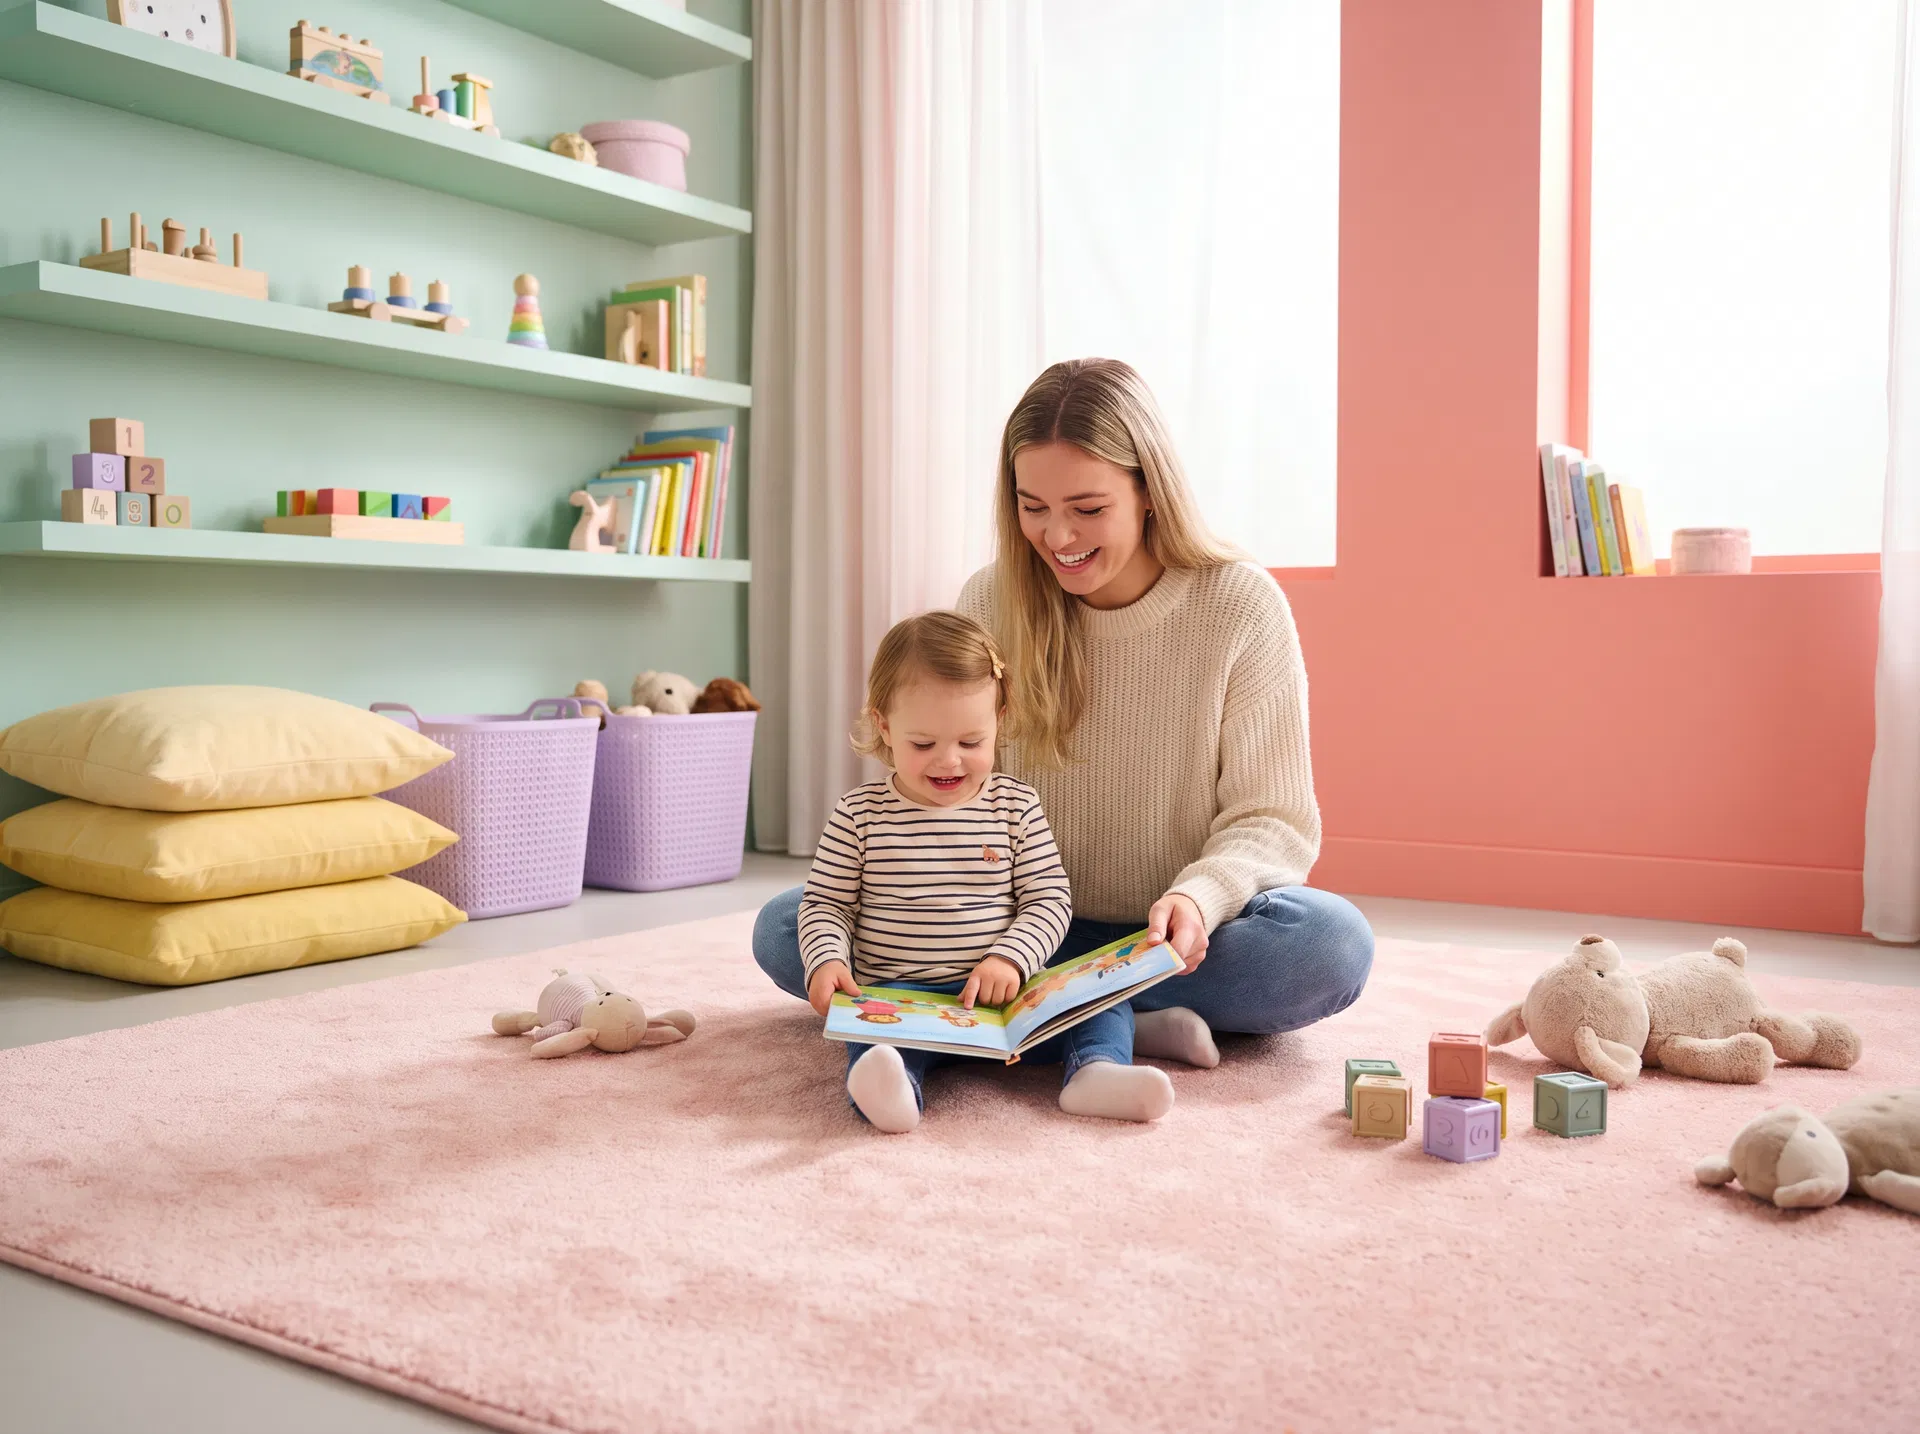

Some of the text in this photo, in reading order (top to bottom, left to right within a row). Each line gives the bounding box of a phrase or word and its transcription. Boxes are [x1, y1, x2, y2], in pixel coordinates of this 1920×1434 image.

[125, 426, 133, 449] 1
[101, 460, 116, 484] 3
[140, 463, 156, 486] 2
[90, 495, 109, 521] 4
